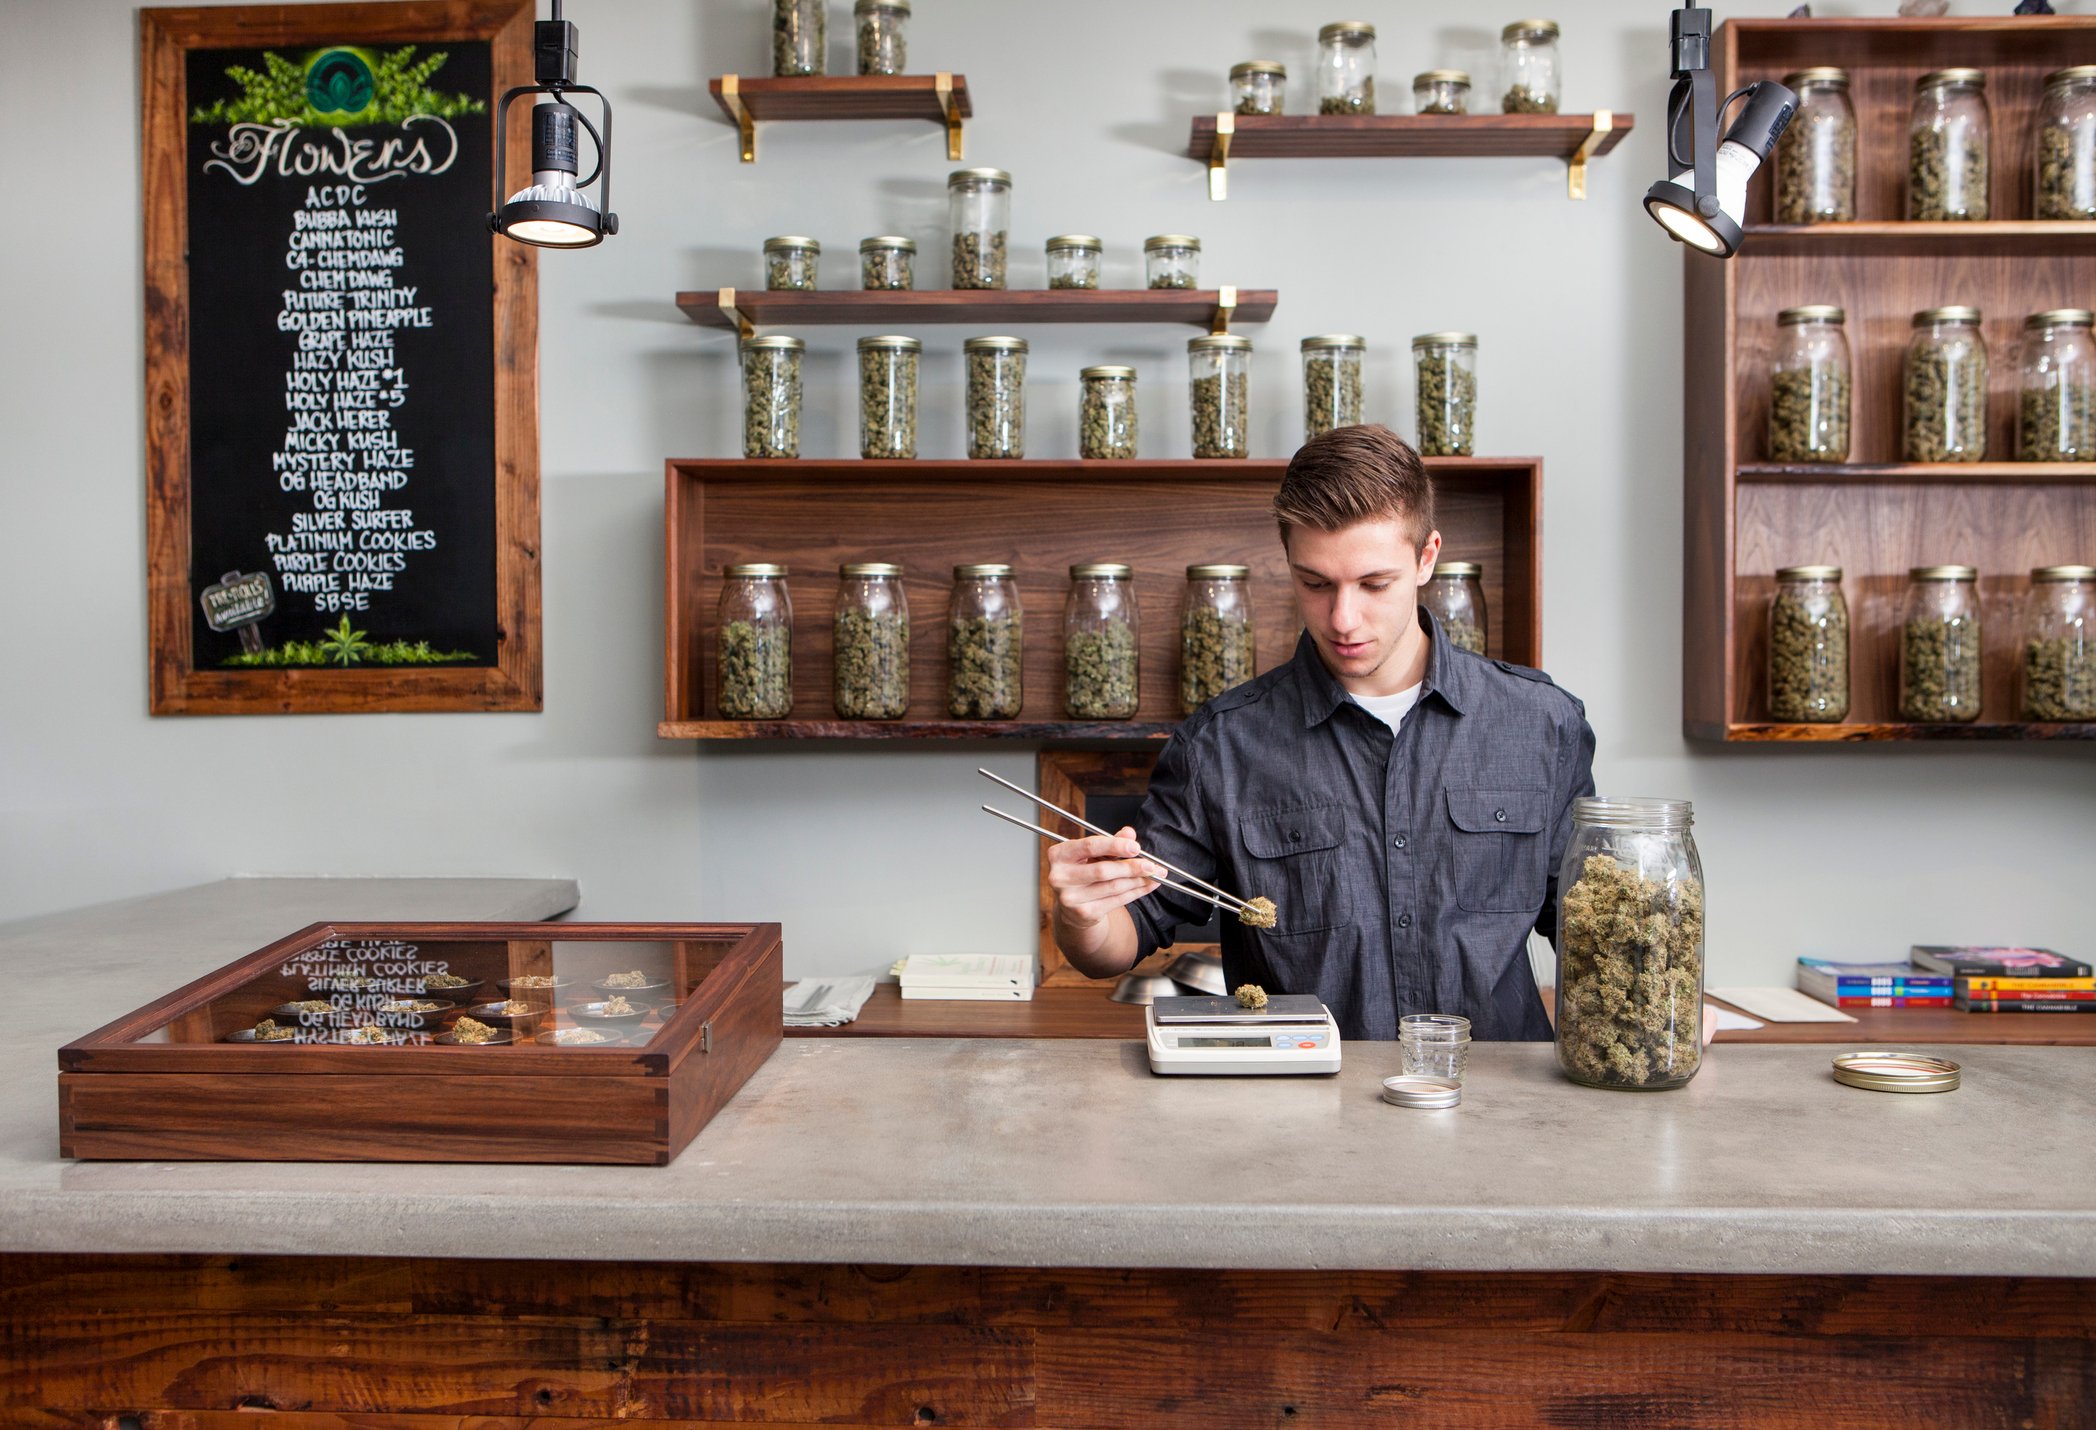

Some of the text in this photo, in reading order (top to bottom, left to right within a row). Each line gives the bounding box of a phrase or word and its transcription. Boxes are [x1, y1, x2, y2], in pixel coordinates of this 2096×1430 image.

[305, 184, 367, 208] ACDC
[293, 208, 398, 231] BUBBA KUSH
[288, 229, 395, 250] CANNATONIC
[282, 286, 417, 311] FUTURE TRINITY
[277, 307, 433, 331] GOLDEN PINEAPPLE
[298, 329, 394, 351] GRAPE HAZE
[293, 348, 394, 370] HAZY KUSH
[286, 371, 333, 392] HOLY
[336, 370, 381, 391] HAZE
[285, 391, 330, 411] HOLY
[333, 390, 377, 411] HAZE
[287, 410, 391, 432] JACK HERER
[284, 430, 398, 451] MICKY KUSH
[272, 449, 414, 472] MYSTERY HAZE
[279, 470, 408, 492] OG HEADBAND
[313, 489, 381, 510] OG KUSH
[292, 509, 414, 532] SILVER SURFER
[265, 530, 437, 552] PLATINUM COOKIES
[272, 551, 406, 573] PURPLE COOKIES
[281, 571, 395, 593] PURPLE HAZE
[314, 592, 371, 613] SBSE
